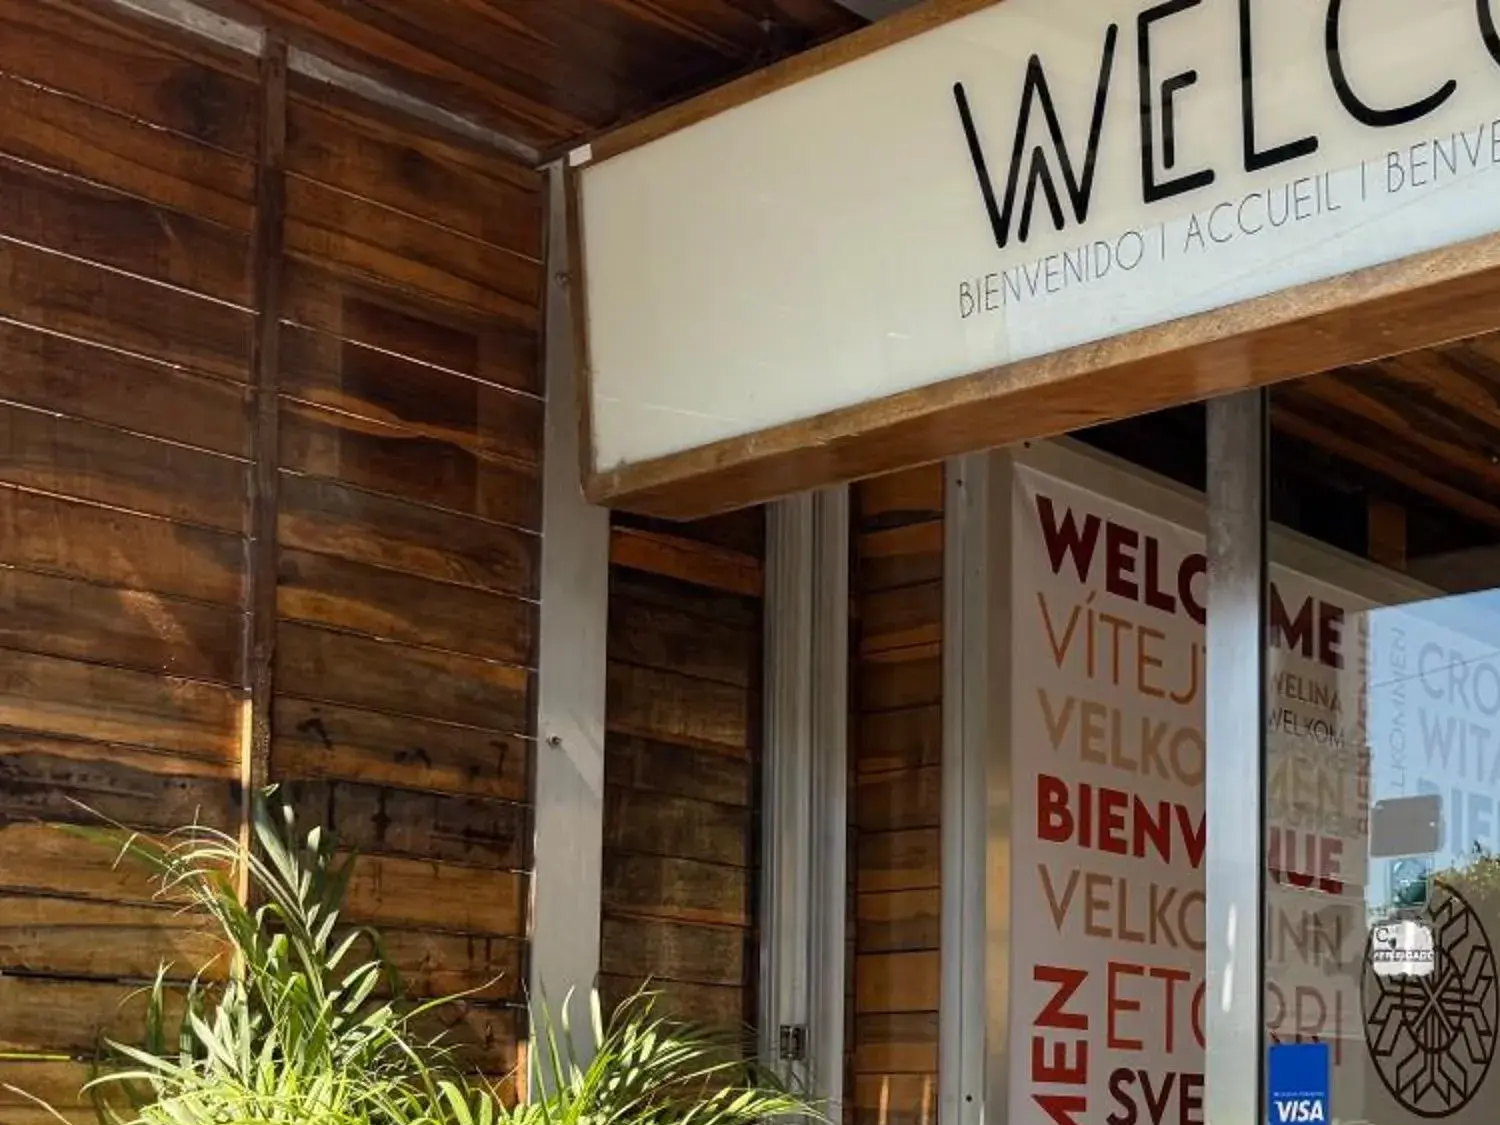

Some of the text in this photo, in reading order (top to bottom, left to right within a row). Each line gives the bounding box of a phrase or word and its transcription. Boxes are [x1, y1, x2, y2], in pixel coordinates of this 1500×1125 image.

[958, 230, 1145, 319] BIENVENIDO
[1183, 174, 1341, 254] ACCUEIL
[1038, 590, 1206, 706] VÍTEJ
[1273, 1100, 1325, 1123] VISA
